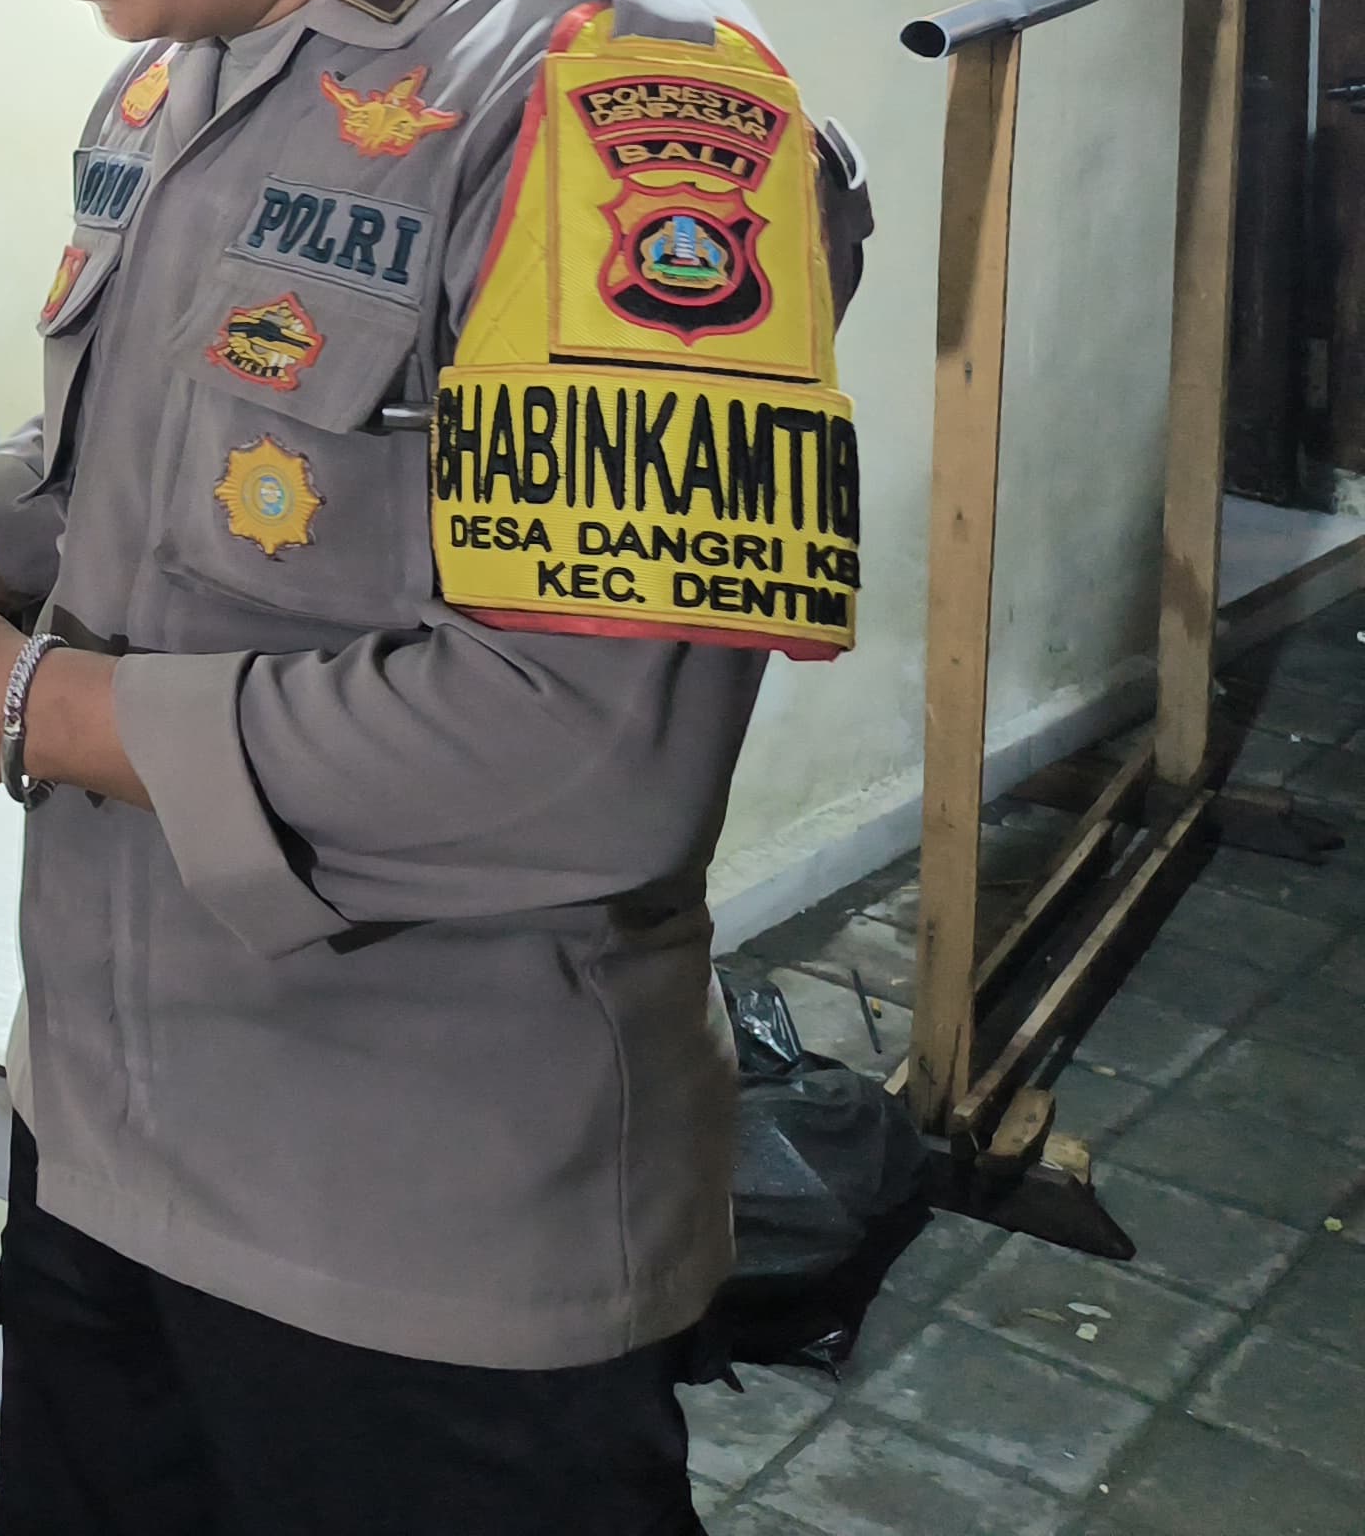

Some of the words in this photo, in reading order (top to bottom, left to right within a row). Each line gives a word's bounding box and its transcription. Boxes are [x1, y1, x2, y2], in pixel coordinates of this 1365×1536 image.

[588, 84, 767, 125] POLRESTA
[590, 103, 768, 141] DENPASAR
[615, 142, 747, 177] BALI
[247, 187, 422, 285] POLRI
[451, 514, 552, 552] DESA
[577, 521, 783, 573] DANGRI
[537, 560, 646, 603] KEC.
